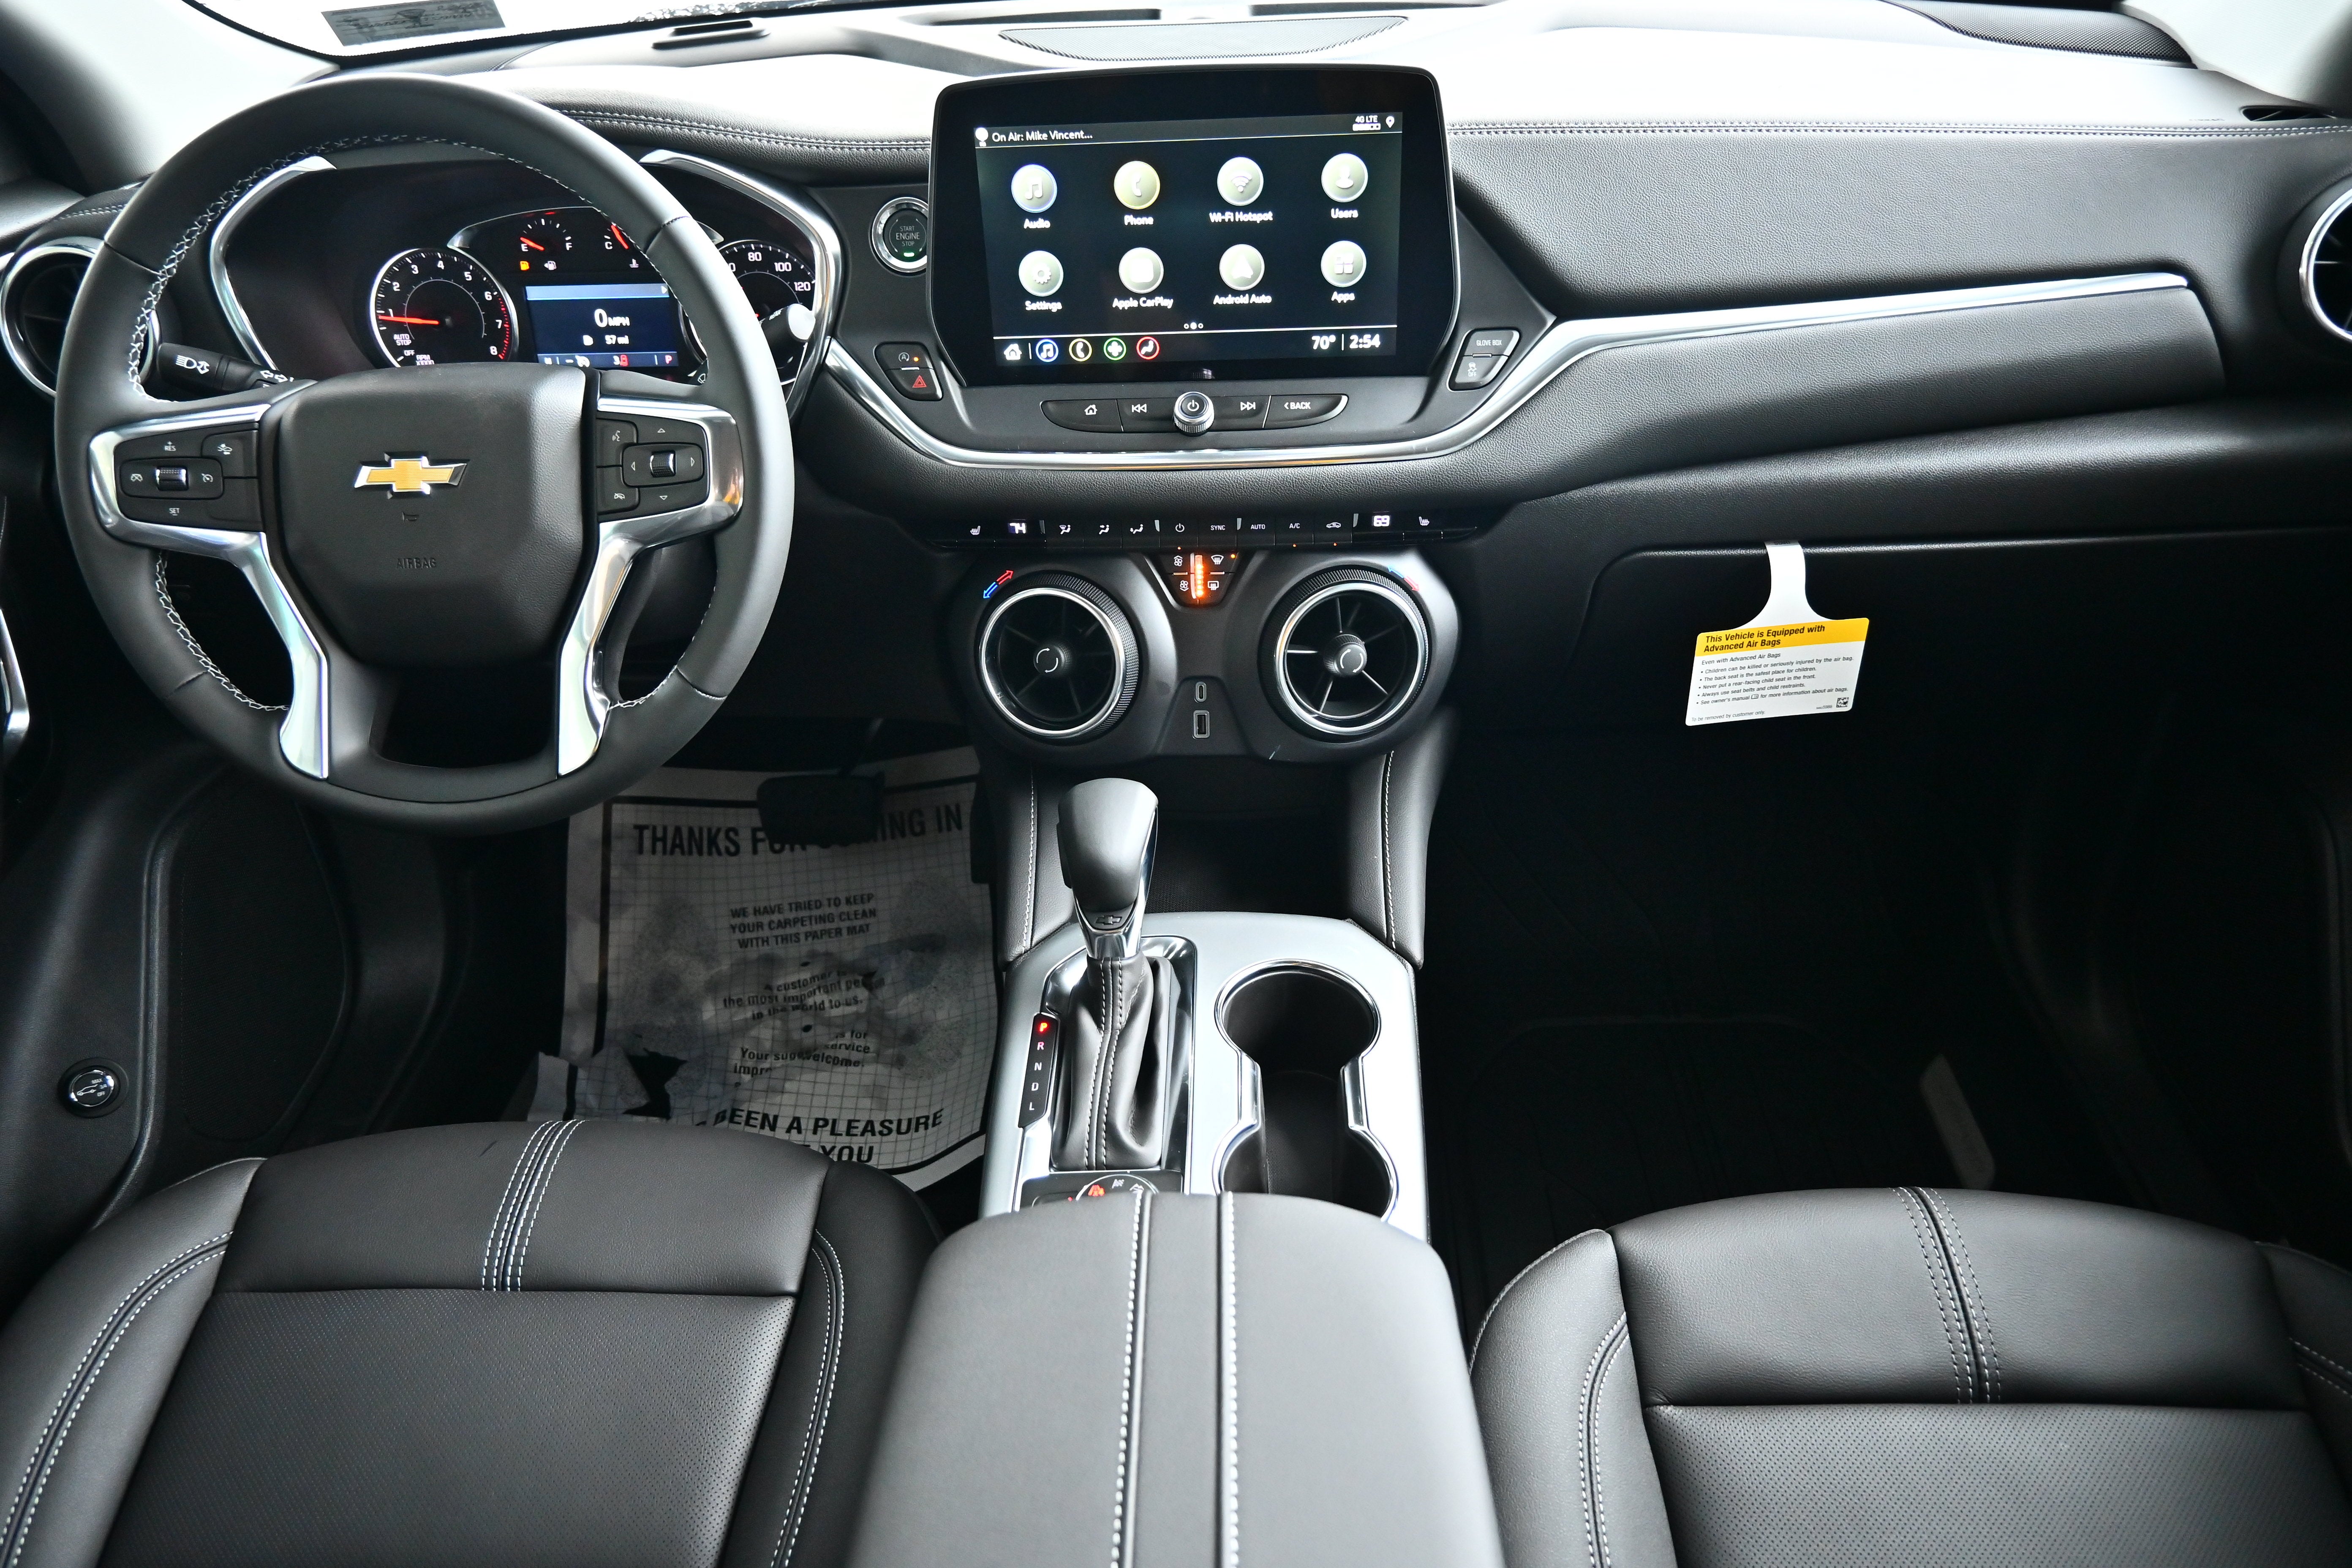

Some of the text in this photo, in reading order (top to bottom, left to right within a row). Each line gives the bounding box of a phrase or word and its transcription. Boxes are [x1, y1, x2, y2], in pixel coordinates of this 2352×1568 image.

[992, 130, 1093, 142] On Air: Mike Vincent...
[1209, 210, 1273, 224] Wi-Fi Hotspot
[1331, 208, 1358, 219] Users
[1024, 218, 1051, 229] Audio
[1124, 214, 1154, 226] Phone
[566, 242, 572, 250] F
[748, 252, 762, 261] 80
[411, 265, 419, 274] 3
[437, 261, 444, 270] 4
[774, 262, 792, 272] 100
[464, 272, 472, 281] 5
[392, 282, 400, 291] 2
[794, 281, 811, 291] 120
[485, 291, 492, 301] 6
[1213, 293, 1272, 305] Android Auto
[1331, 291, 1355, 304] Apps
[1025, 299, 1063, 313] Settings
[1112, 295, 1173, 310] Apple CarPlay
[495, 320, 502, 329] 7
[605, 335, 629, 344] 57 mi
[1312, 333, 1381, 350] 70° 2:54
[490, 346, 498, 355] 8
[665, 355, 672, 364] P
[1290, 401, 1311, 410] BACK
[1373, 515, 1390, 527] 69
[396, 557, 438, 569] AIRBAG
[1706, 634, 1722, 643] This
[1725, 632, 1754, 641] Vehicle
[1767, 626, 1805, 637] Equipped
[1808, 624, 1825, 633] with
[1704, 639, 1781, 653] Advanced Air Bags
[633, 824, 741, 857] THANKS
[934, 803, 964, 833] IN
[730, 893, 874, 918] WE HAVE TRIED TO KEEP
[730, 908, 877, 934] YOUR CARPETING CLEAN
[738, 923, 871, 949] WITH THIS PAPER MAT
[776, 972, 831, 992] customer
[723, 995, 743, 1007] the
[784, 981, 843, 1003] important
[829, 998, 841, 1009] to
[1039, 1022, 1048, 1033] P
[850, 1029, 867, 1039] for
[1037, 1041, 1045, 1051] R
[741, 1047, 770, 1061] Your
[1034, 1062, 1042, 1071] N
[1031, 1082, 1039, 1091] D
[1029, 1102, 1035, 1111] L
[785, 1116, 803, 1135] A
[812, 1108, 944, 1138] PLEASURE
